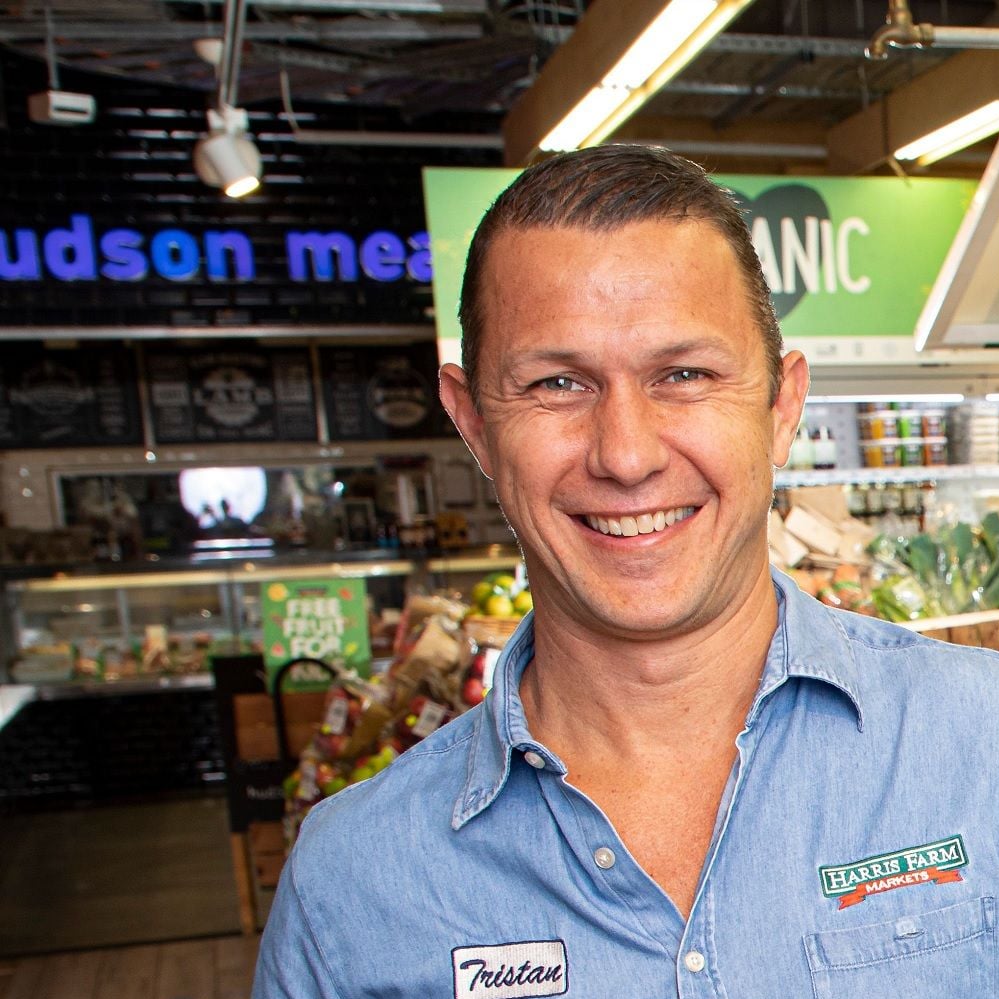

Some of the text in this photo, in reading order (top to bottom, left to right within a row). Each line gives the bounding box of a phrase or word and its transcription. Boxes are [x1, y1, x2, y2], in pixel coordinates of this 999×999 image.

[827, 844, 959, 889] HARRIS FARM
[865, 870, 929, 893] MARKETS
[460, 958, 562, 992] Tristan
